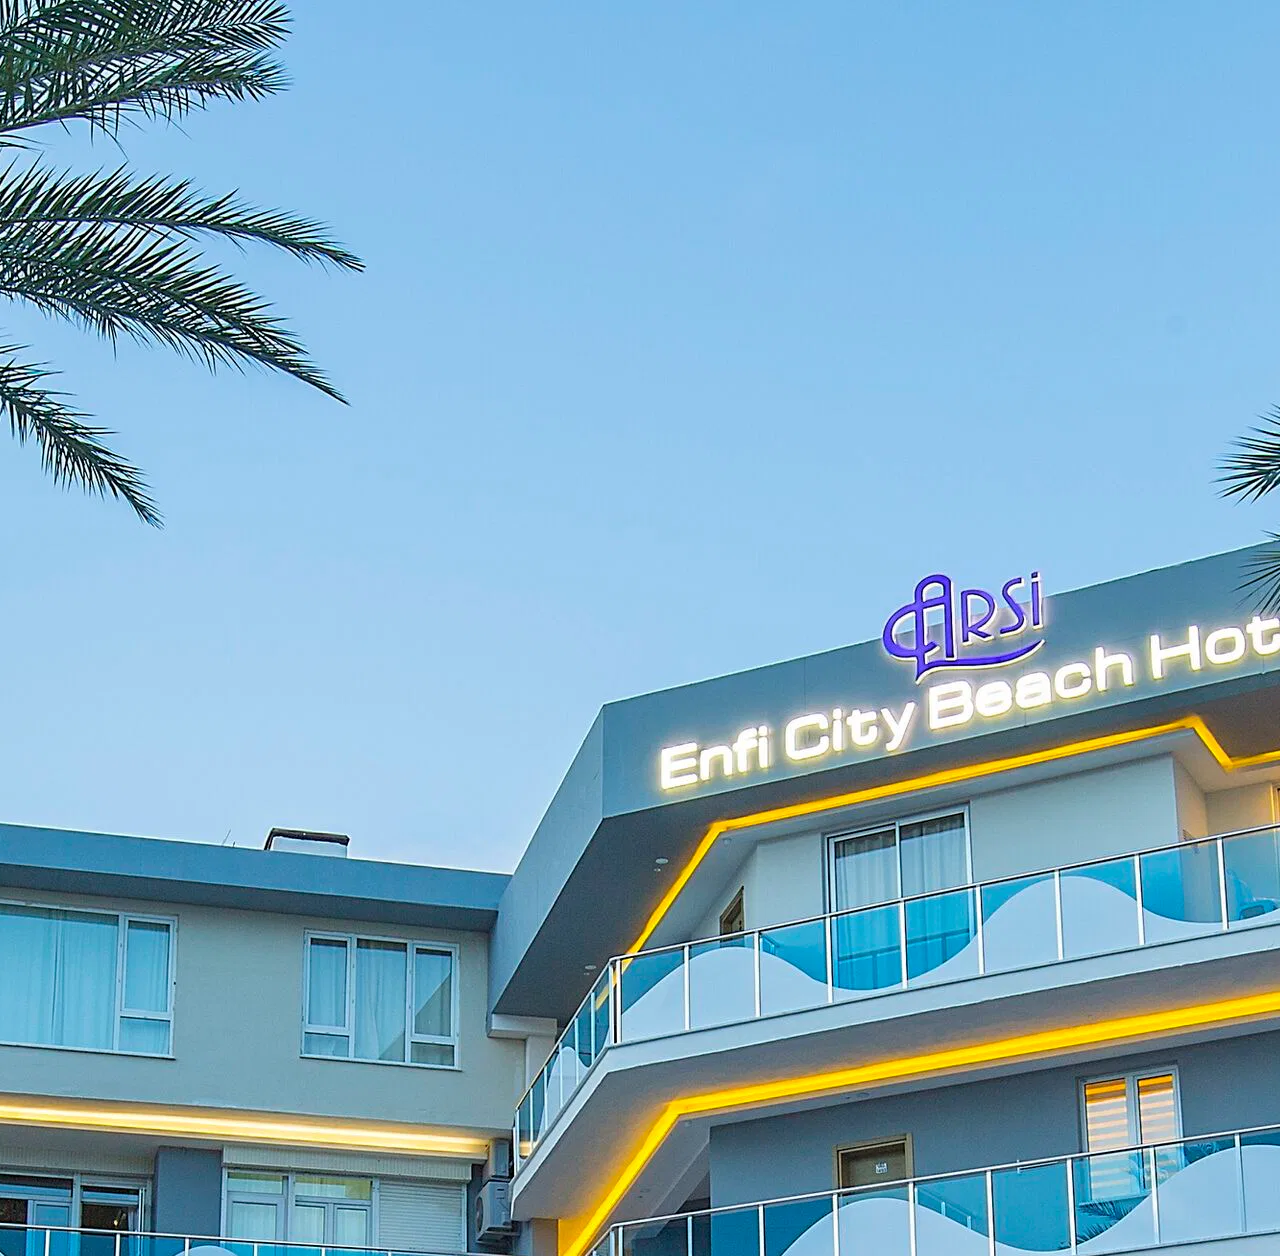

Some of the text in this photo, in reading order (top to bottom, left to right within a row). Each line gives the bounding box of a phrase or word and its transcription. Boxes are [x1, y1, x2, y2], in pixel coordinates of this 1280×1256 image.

[660, 724, 771, 790] Enfi
[784, 701, 918, 762] City
[927, 646, 1135, 731] Beach
